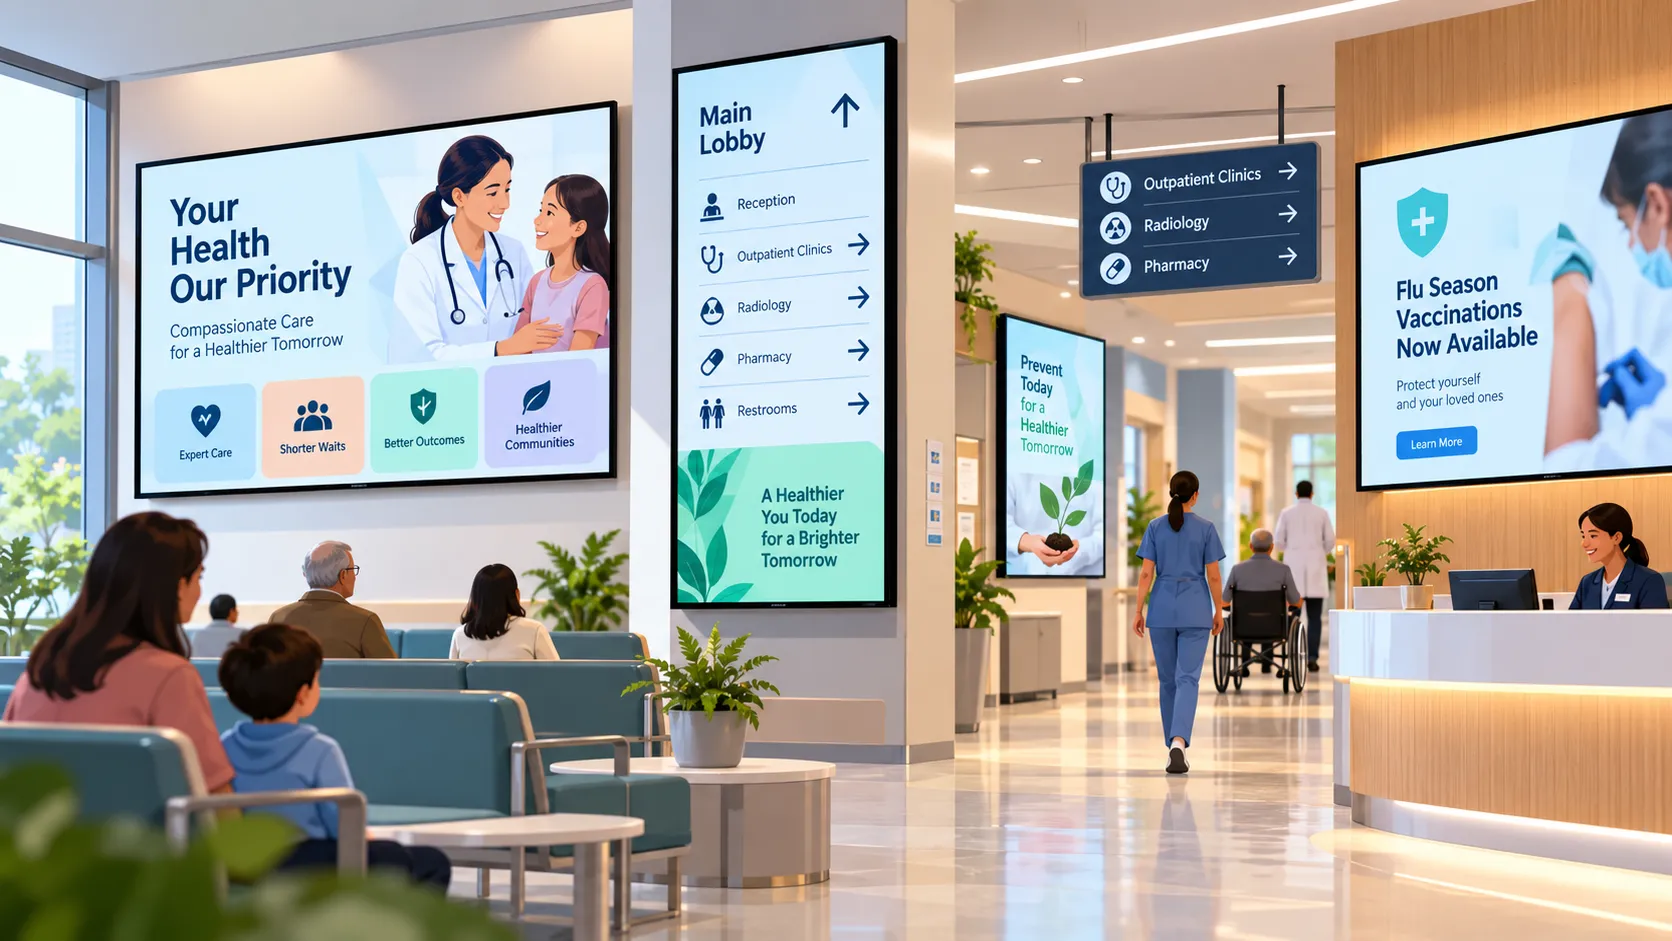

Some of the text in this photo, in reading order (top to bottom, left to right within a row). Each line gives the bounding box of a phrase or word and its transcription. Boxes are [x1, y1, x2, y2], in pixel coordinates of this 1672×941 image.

[701, 101, 751, 127] Main
[701, 129, 765, 155] Lobby
[1144, 168, 1261, 191] Outpatient Clinics
[170, 197, 239, 226] Your
[738, 194, 795, 210] Reception
[1145, 216, 1209, 232] Radiology
[171, 228, 270, 266] Health
[738, 243, 832, 263] Outpatient Clinics
[1145, 259, 1209, 273] Pharmacy
[171, 260, 352, 303] Our Priority
[1397, 275, 1498, 300] Flu Season
[738, 299, 791, 313] Radiology
[1397, 301, 1523, 330] Vaccinations
[170, 314, 313, 339] Compassionate Care
[170, 335, 343, 359] for a Healthier Tomorrow
[1398, 325, 1538, 359] Now Available
[738, 353, 791, 364] Pharmacy
[1021, 355, 1063, 377] Prevent
[1021, 376, 1052, 398] Today
[1397, 372, 1480, 391] Protect yourself
[738, 405, 797, 416] Restrooms
[1021, 397, 1044, 413] for a
[1397, 392, 1503, 411] and your loved ones
[516, 422, 562, 434] Healthier
[1021, 417, 1068, 436] Healthier
[280, 440, 346, 454] Shorter Waits
[384, 436, 465, 449] Better Outcomes
[505, 437, 574, 450] Communities
[1021, 438, 1073, 456] Tomorrow
[1411, 436, 1463, 449] Learn More
[179, 447, 232, 461] Expert Care
[761, 486, 844, 503] A Healthier
[762, 508, 837, 526] You Today
[761, 529, 860, 549] for a Brighter
[761, 553, 837, 567] Tomorrow
